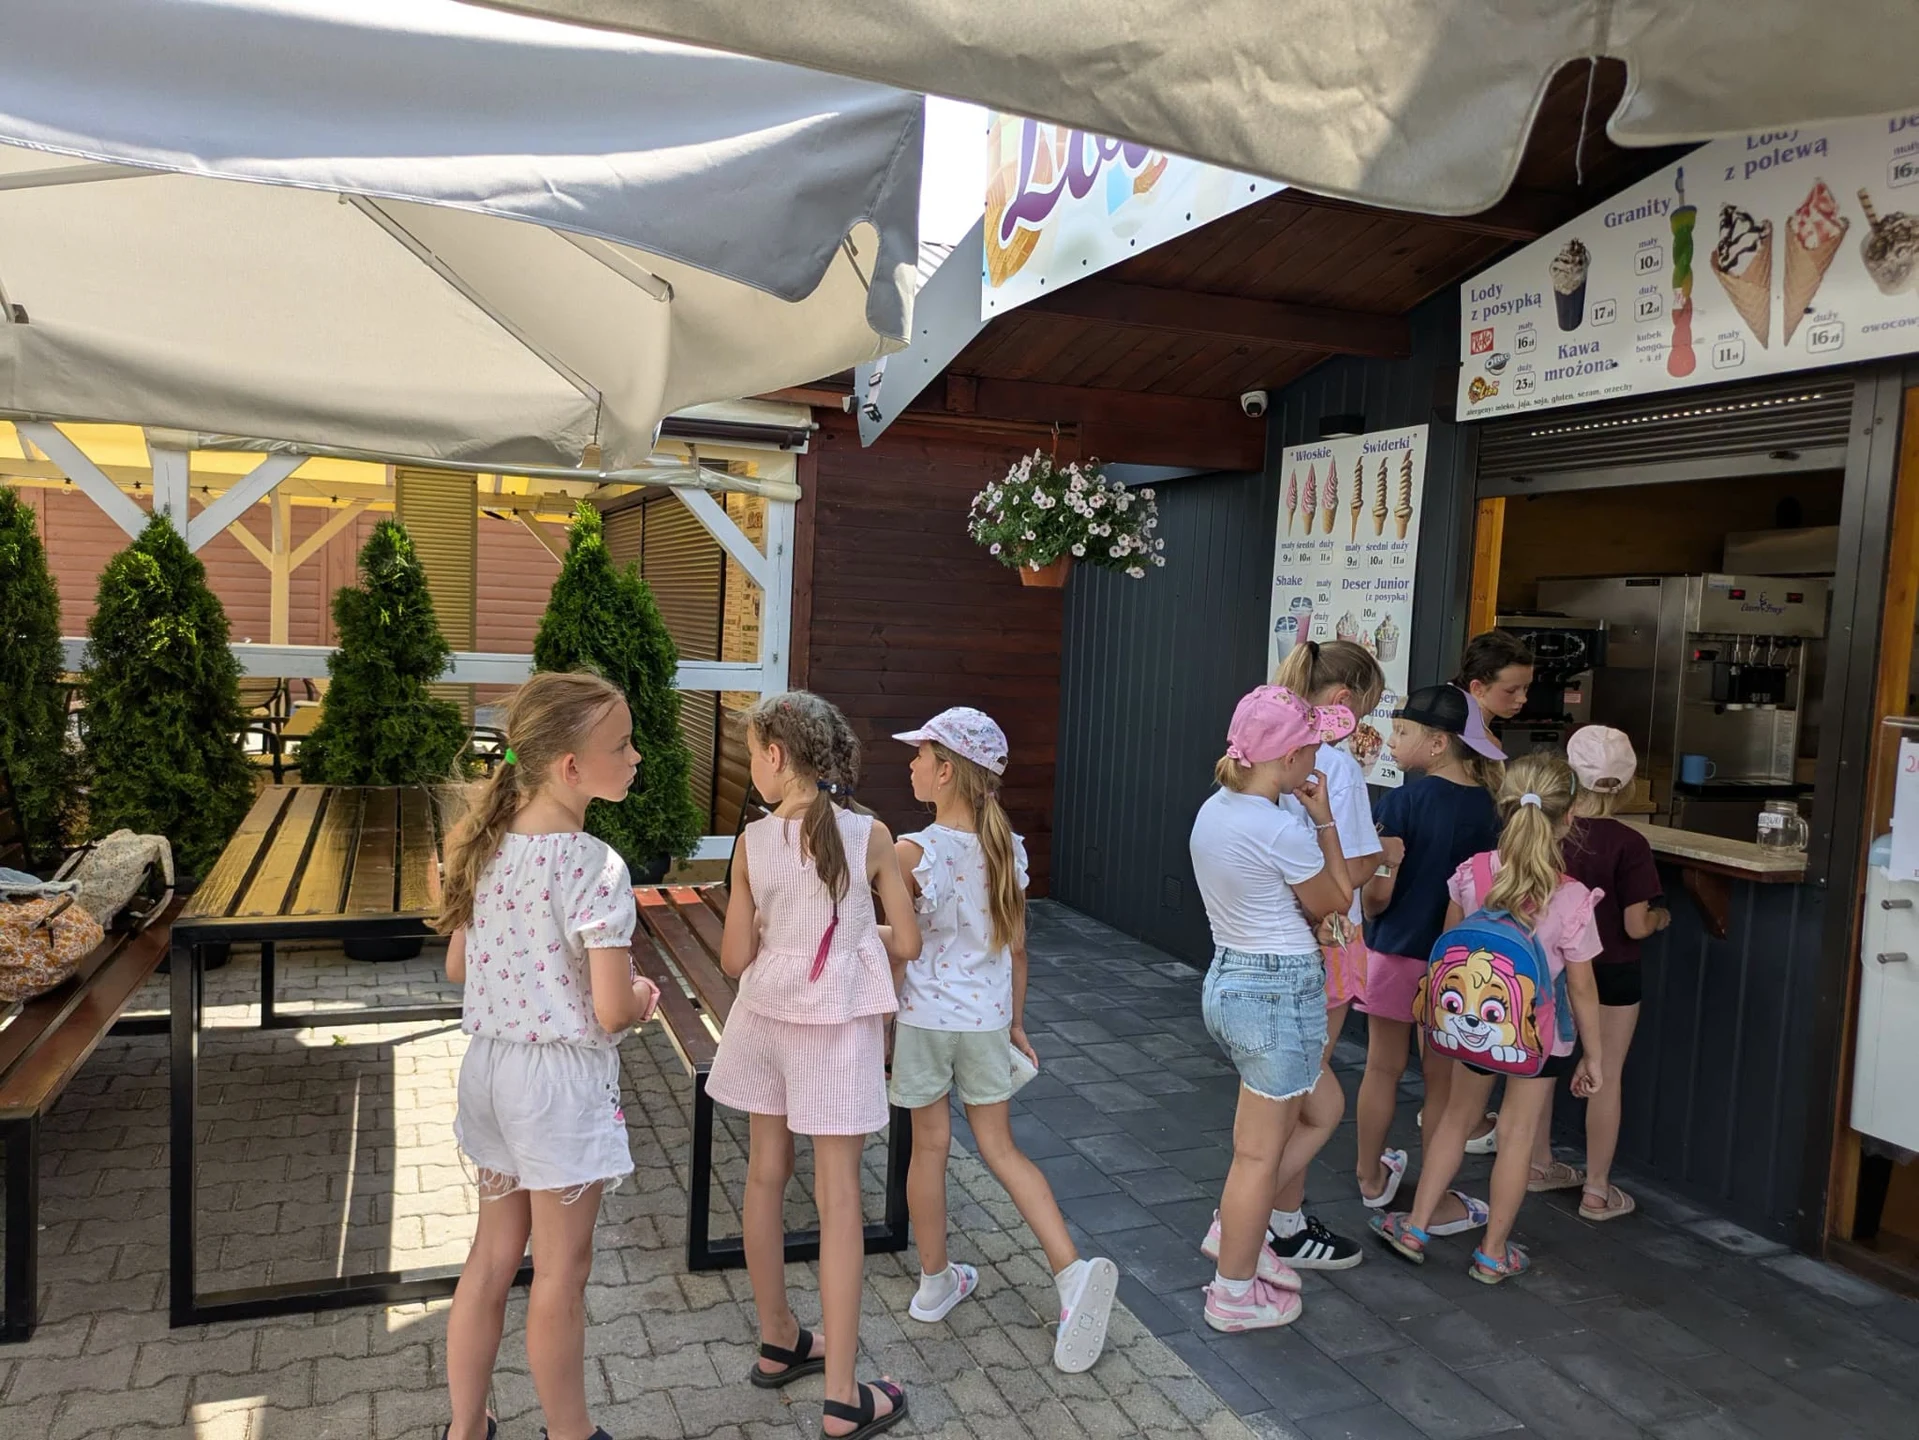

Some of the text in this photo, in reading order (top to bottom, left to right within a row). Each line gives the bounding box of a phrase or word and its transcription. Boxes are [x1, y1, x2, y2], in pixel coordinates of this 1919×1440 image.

[1724, 137, 1828, 181] z polewą
[1604, 198, 1671, 228] Granity
[1638, 238, 1658, 249] mały
[1471, 283, 1503, 303] Lody
[1638, 284, 1658, 296] duży
[1471, 293, 1542, 321] z posypką
[1813, 310, 1839, 323] duży
[1518, 321, 1533, 331] mały
[1636, 330, 1662, 342] kubek
[1718, 330, 1739, 341] mały
[1558, 340, 1600, 360] Kawa
[1635, 343, 1662, 353] bongo
[1544, 359, 1614, 382] mrożona
[1363, 435, 1410, 455] Świderki
[1296, 447, 1332, 463] Włoskie
[1281, 539, 1334, 551] mały średni duży
[1345, 540, 1409, 552] mały średni duży
[1275, 575, 1303, 587] Shake
[1316, 579, 1331, 588] mały
[1342, 577, 1410, 590] Deser Junior
[1314, 612, 1329, 621] duży
